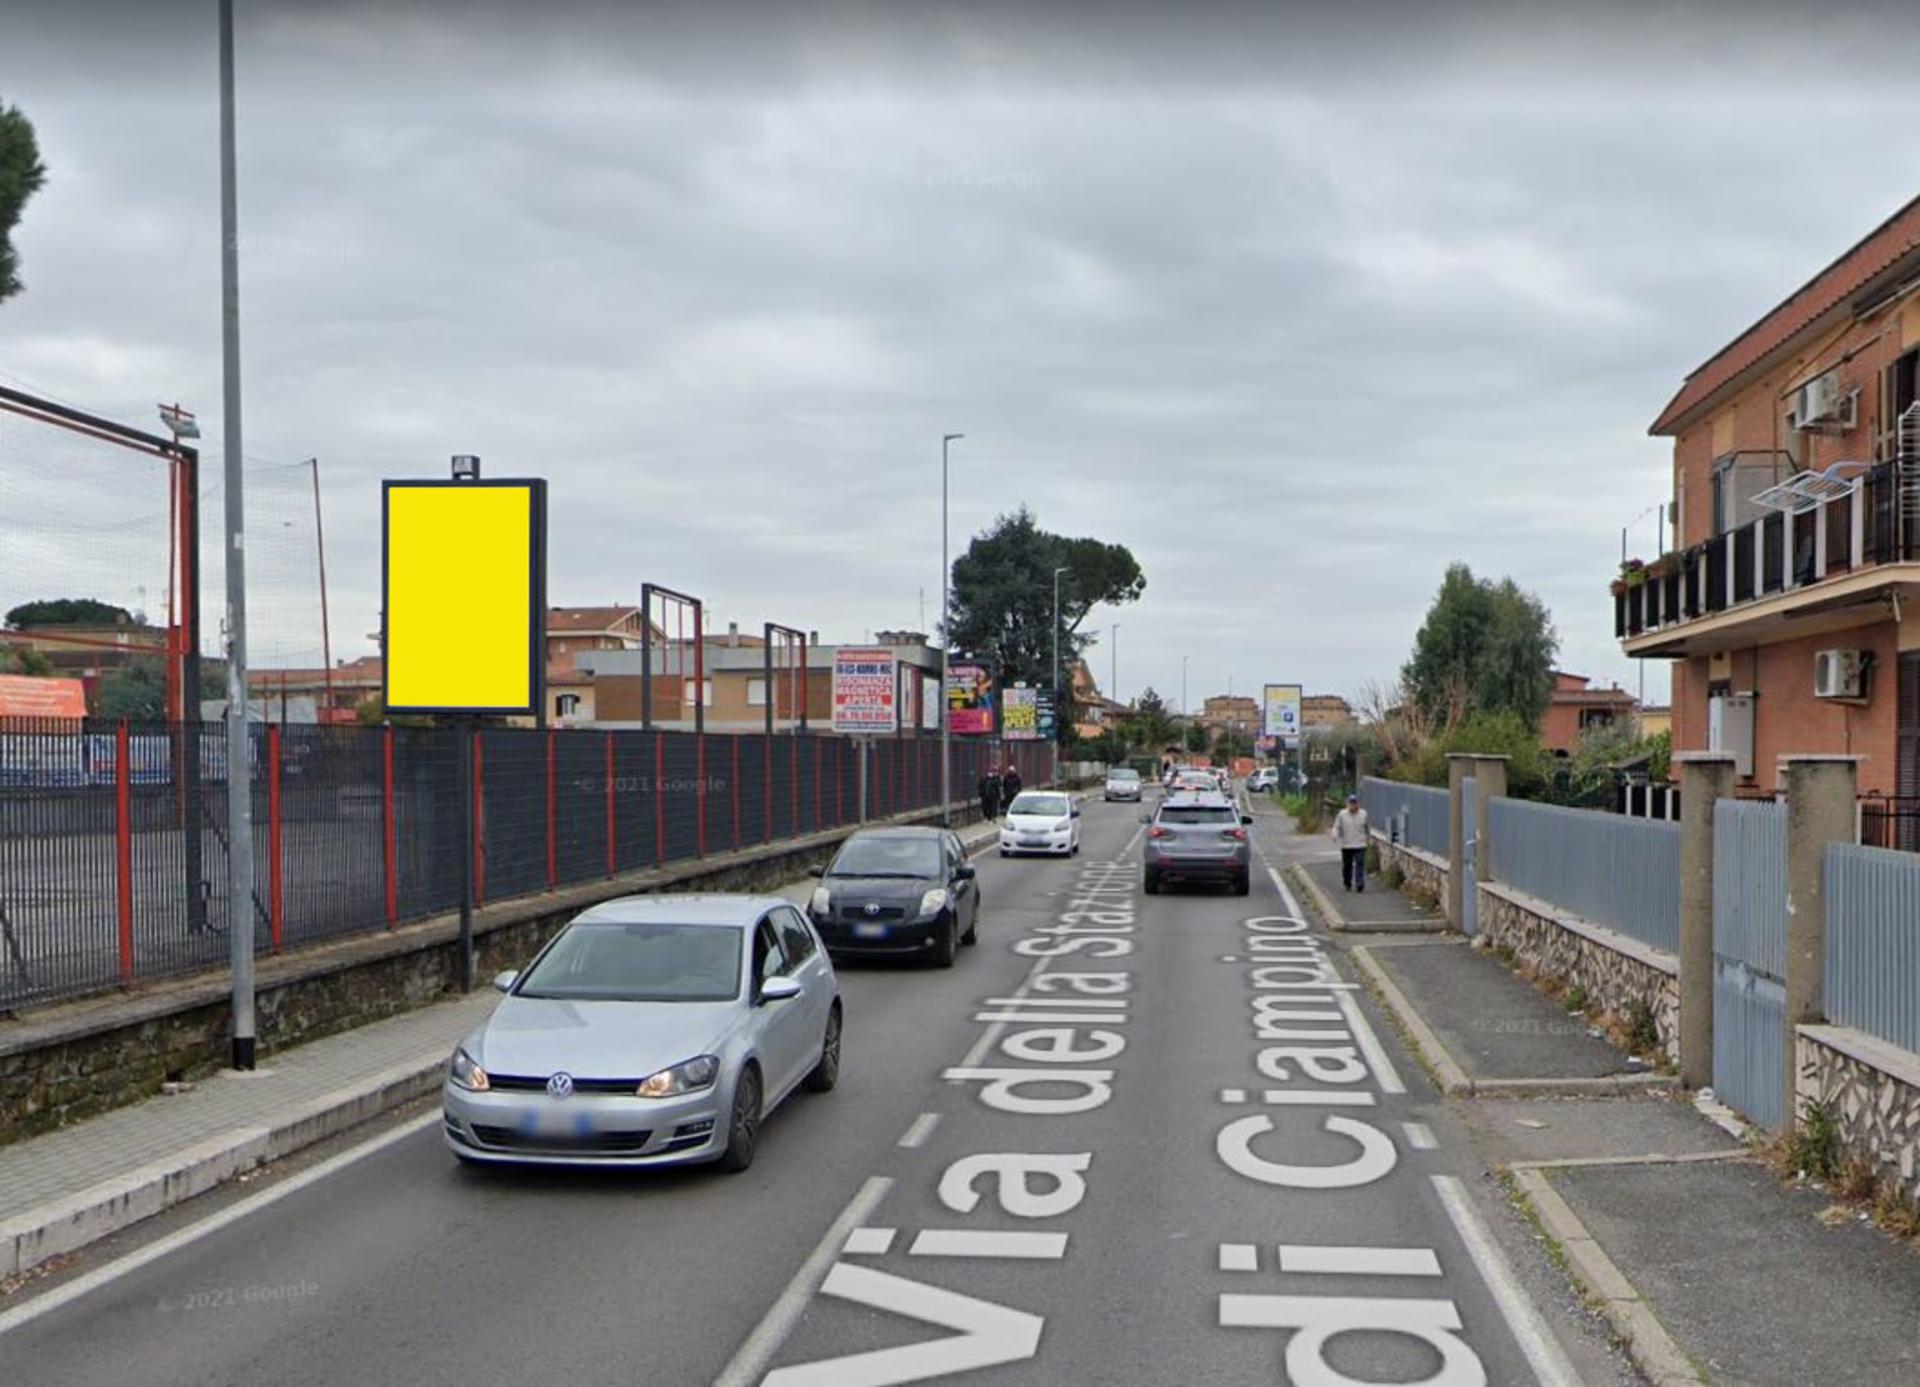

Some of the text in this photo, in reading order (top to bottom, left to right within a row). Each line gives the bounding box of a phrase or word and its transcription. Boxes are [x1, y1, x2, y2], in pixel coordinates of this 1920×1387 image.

[758, 860, 1138, 1387] Via della Stazione
[1216, 915, 1487, 1387] di Ciampino
